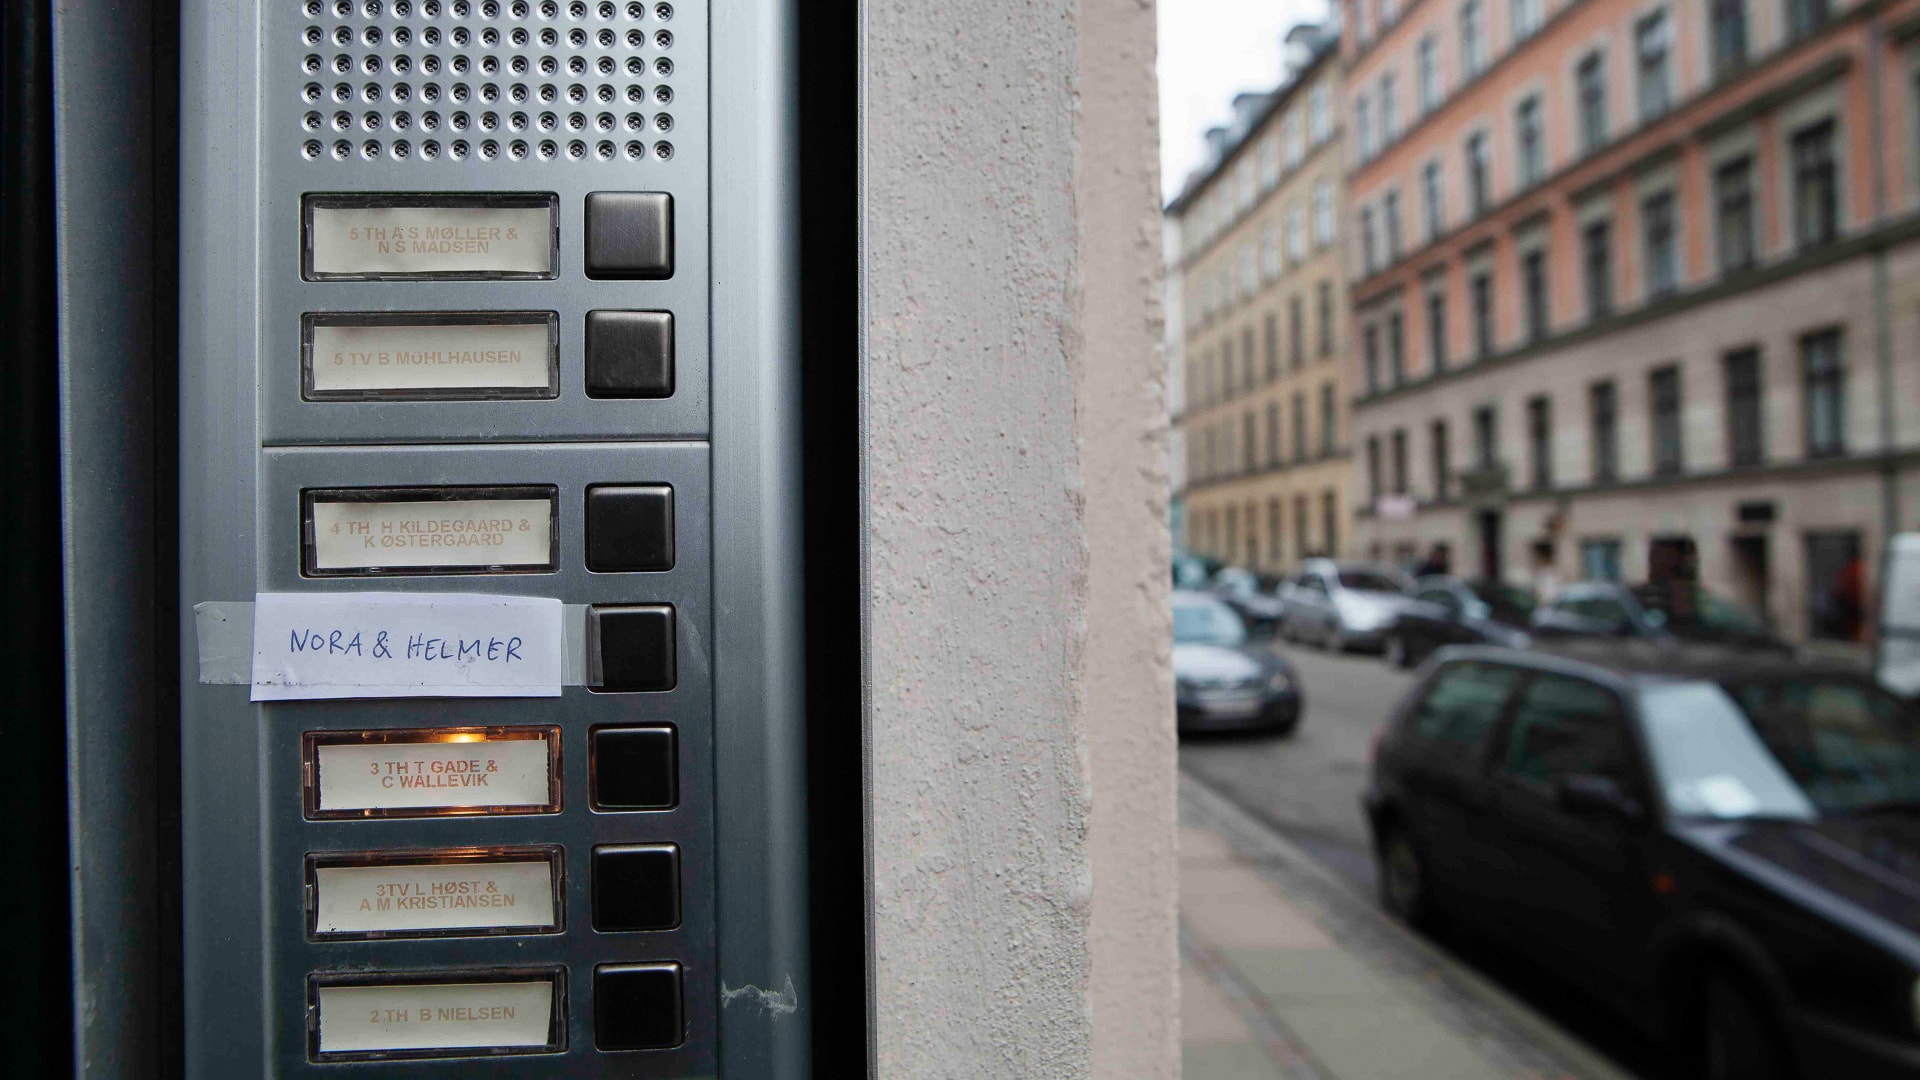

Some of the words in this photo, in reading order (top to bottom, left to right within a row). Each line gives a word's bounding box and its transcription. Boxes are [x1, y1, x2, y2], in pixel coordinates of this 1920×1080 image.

[350, 228, 358, 240] 5
[364, 228, 386, 240] TH
[392, 227, 403, 240] A
[408, 227, 418, 240] S
[426, 227, 500, 240] MØLLER
[506, 228, 518, 240] &
[378, 241, 389, 254] N
[395, 241, 406, 254] S
[413, 241, 489, 254] MADSEN
[334, 353, 343, 366] 5
[350, 353, 371, 365] TV
[378, 352, 390, 364] B
[331, 522, 339, 535] 4
[347, 521, 369, 535] TH
[381, 521, 393, 534] H
[400, 520, 513, 533] KILDEGAARD
[518, 519, 531, 530] &
[365, 536, 375, 548] K
[381, 534, 504, 547] ØSTERGAARD
[291, 629, 361, 656] NORA
[373, 631, 392, 658] &
[407, 633, 522, 663] HELMER
[371, 763, 379, 775] 3
[385, 762, 408, 775] TH
[414, 761, 424, 773] T
[430, 760, 480, 773] GADE
[486, 759, 498, 772] &
[382, 776, 394, 788] C
[399, 773, 489, 788] WALLEVIK
[377, 883, 409, 896] 3TV
[416, 883, 425, 895] L
[432, 882, 479, 895] HØST
[486, 881, 498, 893] &
[359, 899, 371, 911] A
[377, 898, 390, 911] M
[397, 894, 515, 910] KRISTIANSEN
[371, 1010, 379, 1023] 2
[385, 1009, 408, 1022] TH
[420, 1009, 431, 1021] B
[438, 1006, 515, 1021] NIELSEN
